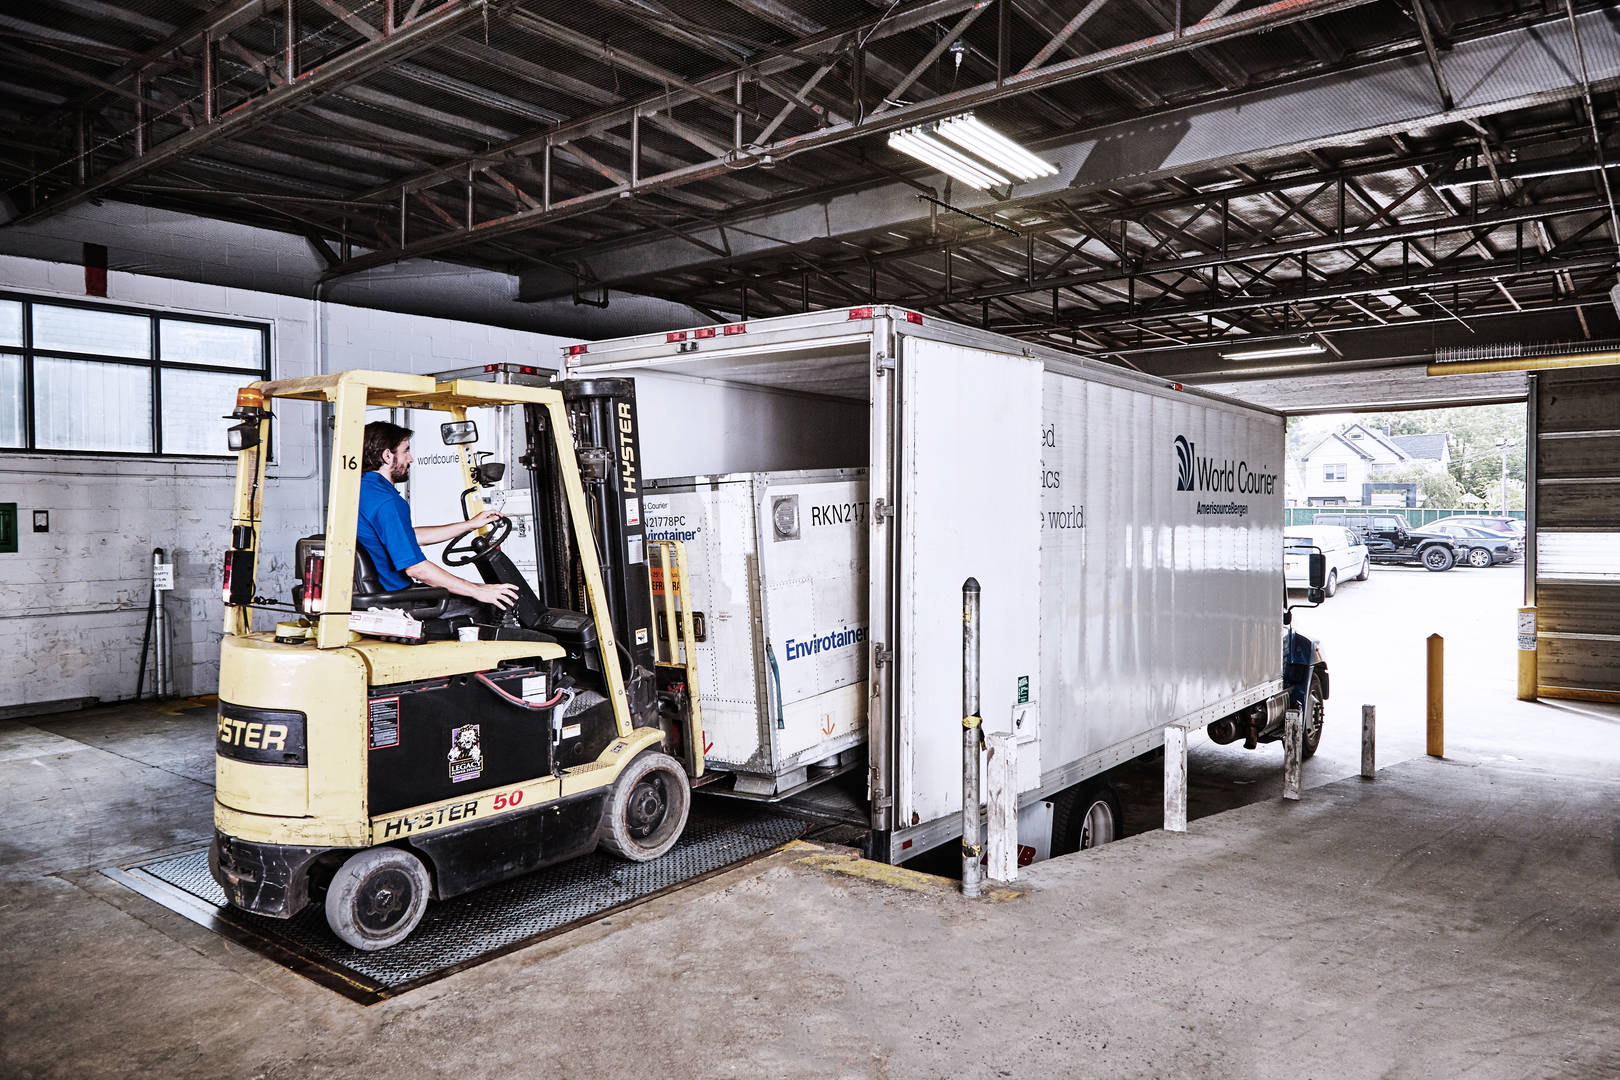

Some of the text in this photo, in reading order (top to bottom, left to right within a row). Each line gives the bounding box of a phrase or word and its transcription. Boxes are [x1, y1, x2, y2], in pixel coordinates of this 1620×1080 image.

[617, 402, 637, 494] HYSTER
[342, 455, 358, 470] 16
[417, 453, 460, 466] worldcourie
[1196, 456, 1277, 495] World Courier
[811, 501, 870, 527] RKN217
[1196, 501, 1249, 518] AmerisourceBergen
[645, 528, 696, 541] virotainer
[785, 625, 869, 661] Envirotainer
[451, 760, 482, 772] LEGACY
[384, 790, 523, 838] HYSTER 50
